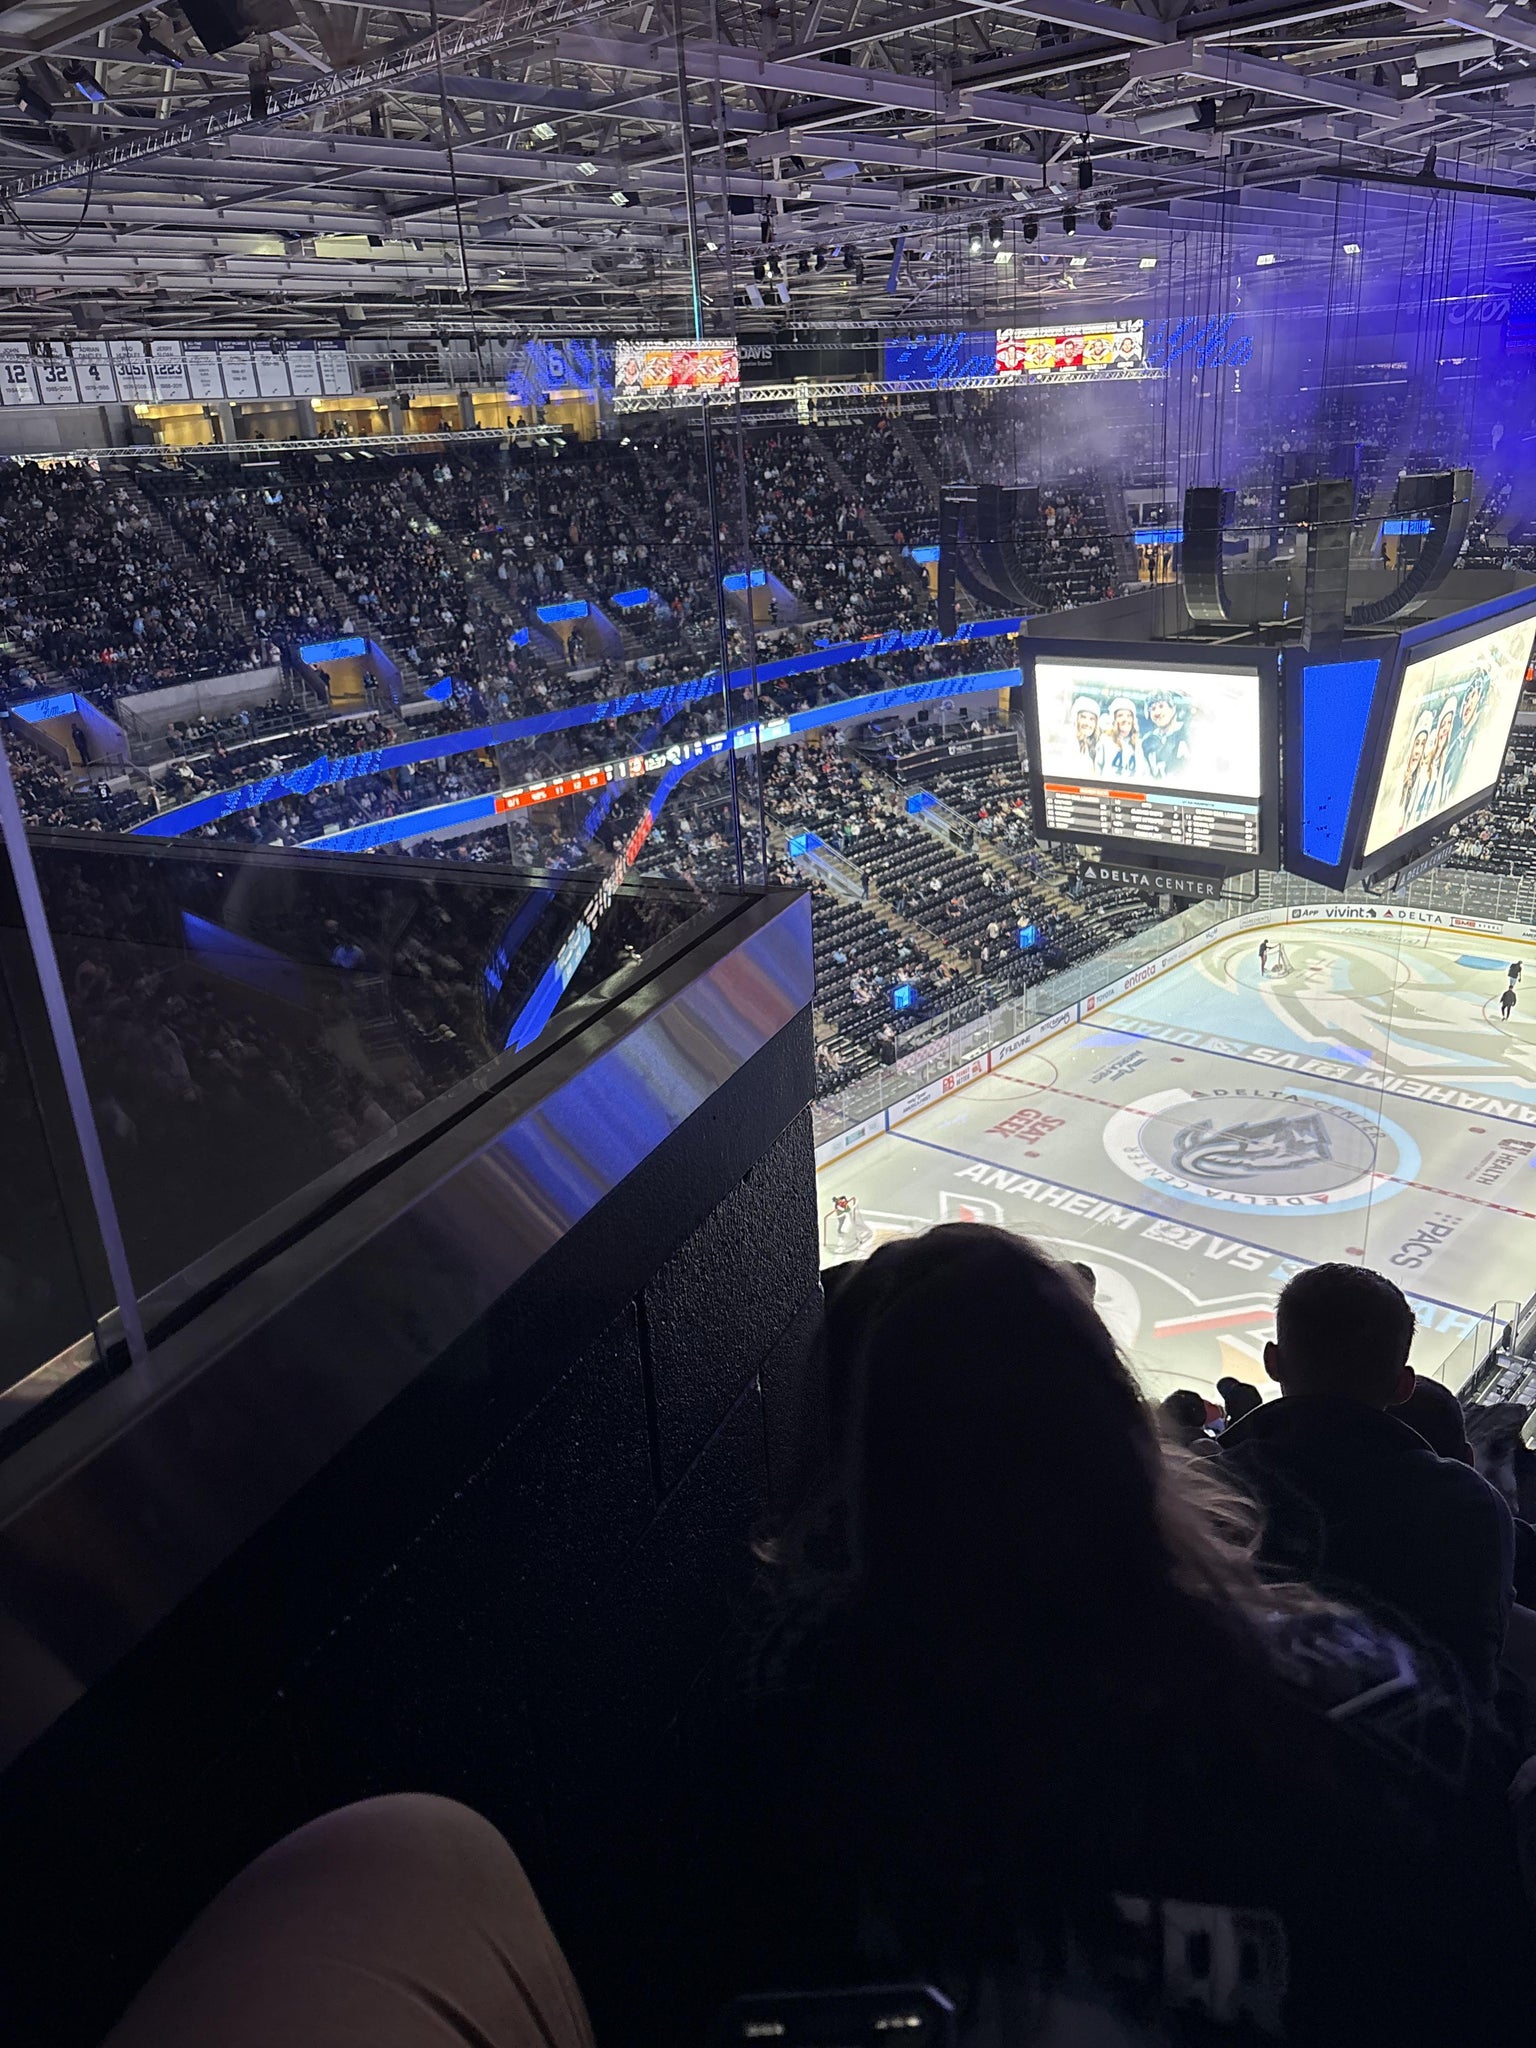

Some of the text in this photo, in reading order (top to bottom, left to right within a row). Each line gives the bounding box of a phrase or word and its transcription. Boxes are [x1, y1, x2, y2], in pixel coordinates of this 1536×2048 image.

[4, 364, 27, 383] 12
[43, 365, 68, 382] 32
[88, 363, 101, 382] 4
[117, 364, 147, 376] 3051
[154, 363, 183, 375] 1223
[1100, 868, 1214, 895] DELTA CENTER
[1398, 910, 1442, 924] DELTA
[1124, 962, 1156, 990] entrata
[1109, 1017, 1536, 1124] ANAHEIM VS UTAH
[984, 1107, 1043, 1139] GEEK
[1212, 1088, 1388, 1140] DELTA CENTER
[1015, 1115, 1066, 1145] SEAT
[1122, 1145, 1305, 1206] DELTA CENTER
[1475, 1152, 1519, 1186] HEALTH
[954, 1162, 1144, 1231] ANAHEIM
[1203, 1234, 1272, 1271] VS
[1389, 1221, 1455, 1269] PACS
